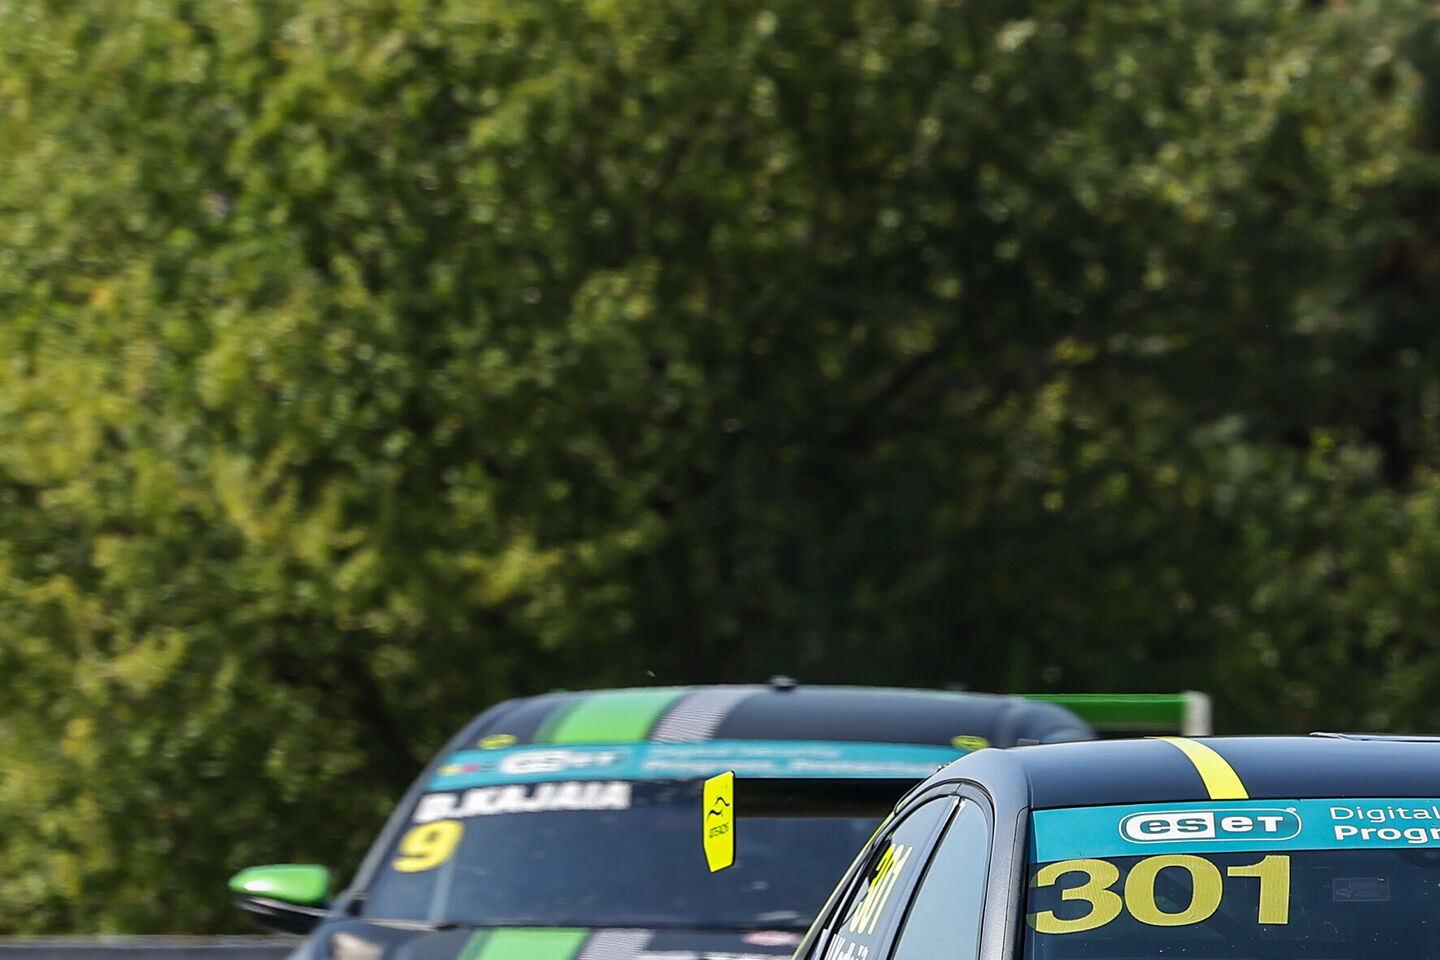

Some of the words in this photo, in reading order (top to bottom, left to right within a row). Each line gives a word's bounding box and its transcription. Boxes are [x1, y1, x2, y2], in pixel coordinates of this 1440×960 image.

[392, 819, 465, 872] 9
[1330, 806, 1440, 823] Digital
[850, 843, 913, 935] 301
[1026, 854, 1290, 934] 301
